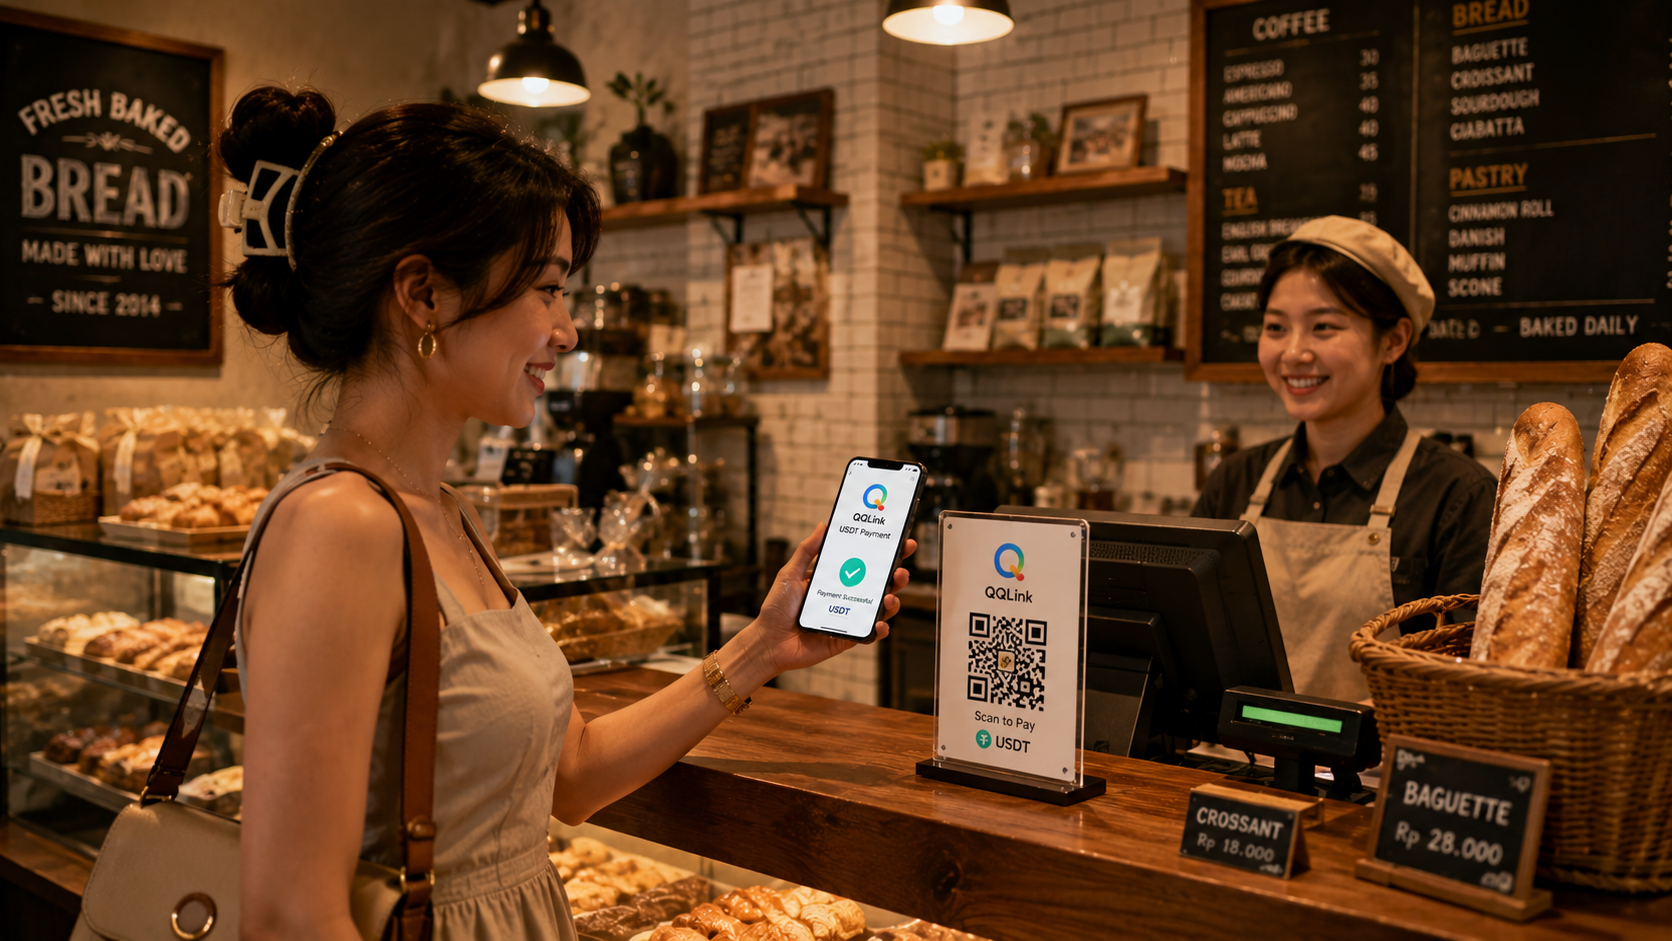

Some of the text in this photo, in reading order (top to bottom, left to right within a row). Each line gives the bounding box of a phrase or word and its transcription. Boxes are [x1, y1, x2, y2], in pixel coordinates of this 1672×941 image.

[1252, 8, 1331, 41] COFFEE
[1452, 0, 1529, 28] BREAD
[1452, 36, 1528, 64] BAGUETTE
[1224, 59, 1284, 83] ESPRESSO
[1450, 62, 1535, 90] CROISSANT
[1223, 81, 1293, 104] AMERICANO
[1450, 88, 1540, 116] SOURDOUGH
[18, 88, 192, 154] FRESH BAKED
[1222, 103, 1298, 128] CAPPUCCINO
[1222, 130, 1262, 150] LATTE
[1450, 116, 1525, 141] CIABATTA
[1222, 152, 1268, 172] MOCHA
[1450, 162, 1529, 190] PASTRY
[20, 154, 190, 230] BREAD
[1222, 187, 1258, 209] TEA
[1448, 199, 1555, 223] CINNAMON ROLL
[1448, 227, 1505, 248] DANISH
[21, 239, 188, 274] MADE WITH LOVE
[1448, 252, 1506, 273] MUFFIN
[1448, 277, 1502, 297] SCONE
[52, 289, 162, 318] SINCE 2014
[1520, 316, 1578, 338] BAKED
[1584, 314, 1639, 336] DAILY
[853, 513, 886, 525] QQLink
[839, 525, 891, 539] USDT Payment
[817, 589, 842, 599] Payment
[985, 586, 1033, 603] QQLink
[828, 605, 851, 615] USDT
[974, 710, 1036, 733] Scan to Pay
[996, 736, 1031, 753] USDT
[1403, 780, 1513, 827] BAGUETTE
[1196, 807, 1284, 840] CROSSANT
[1197, 832, 1274, 862] Rp 18.000
[1394, 820, 1504, 866] Rp 28.000
